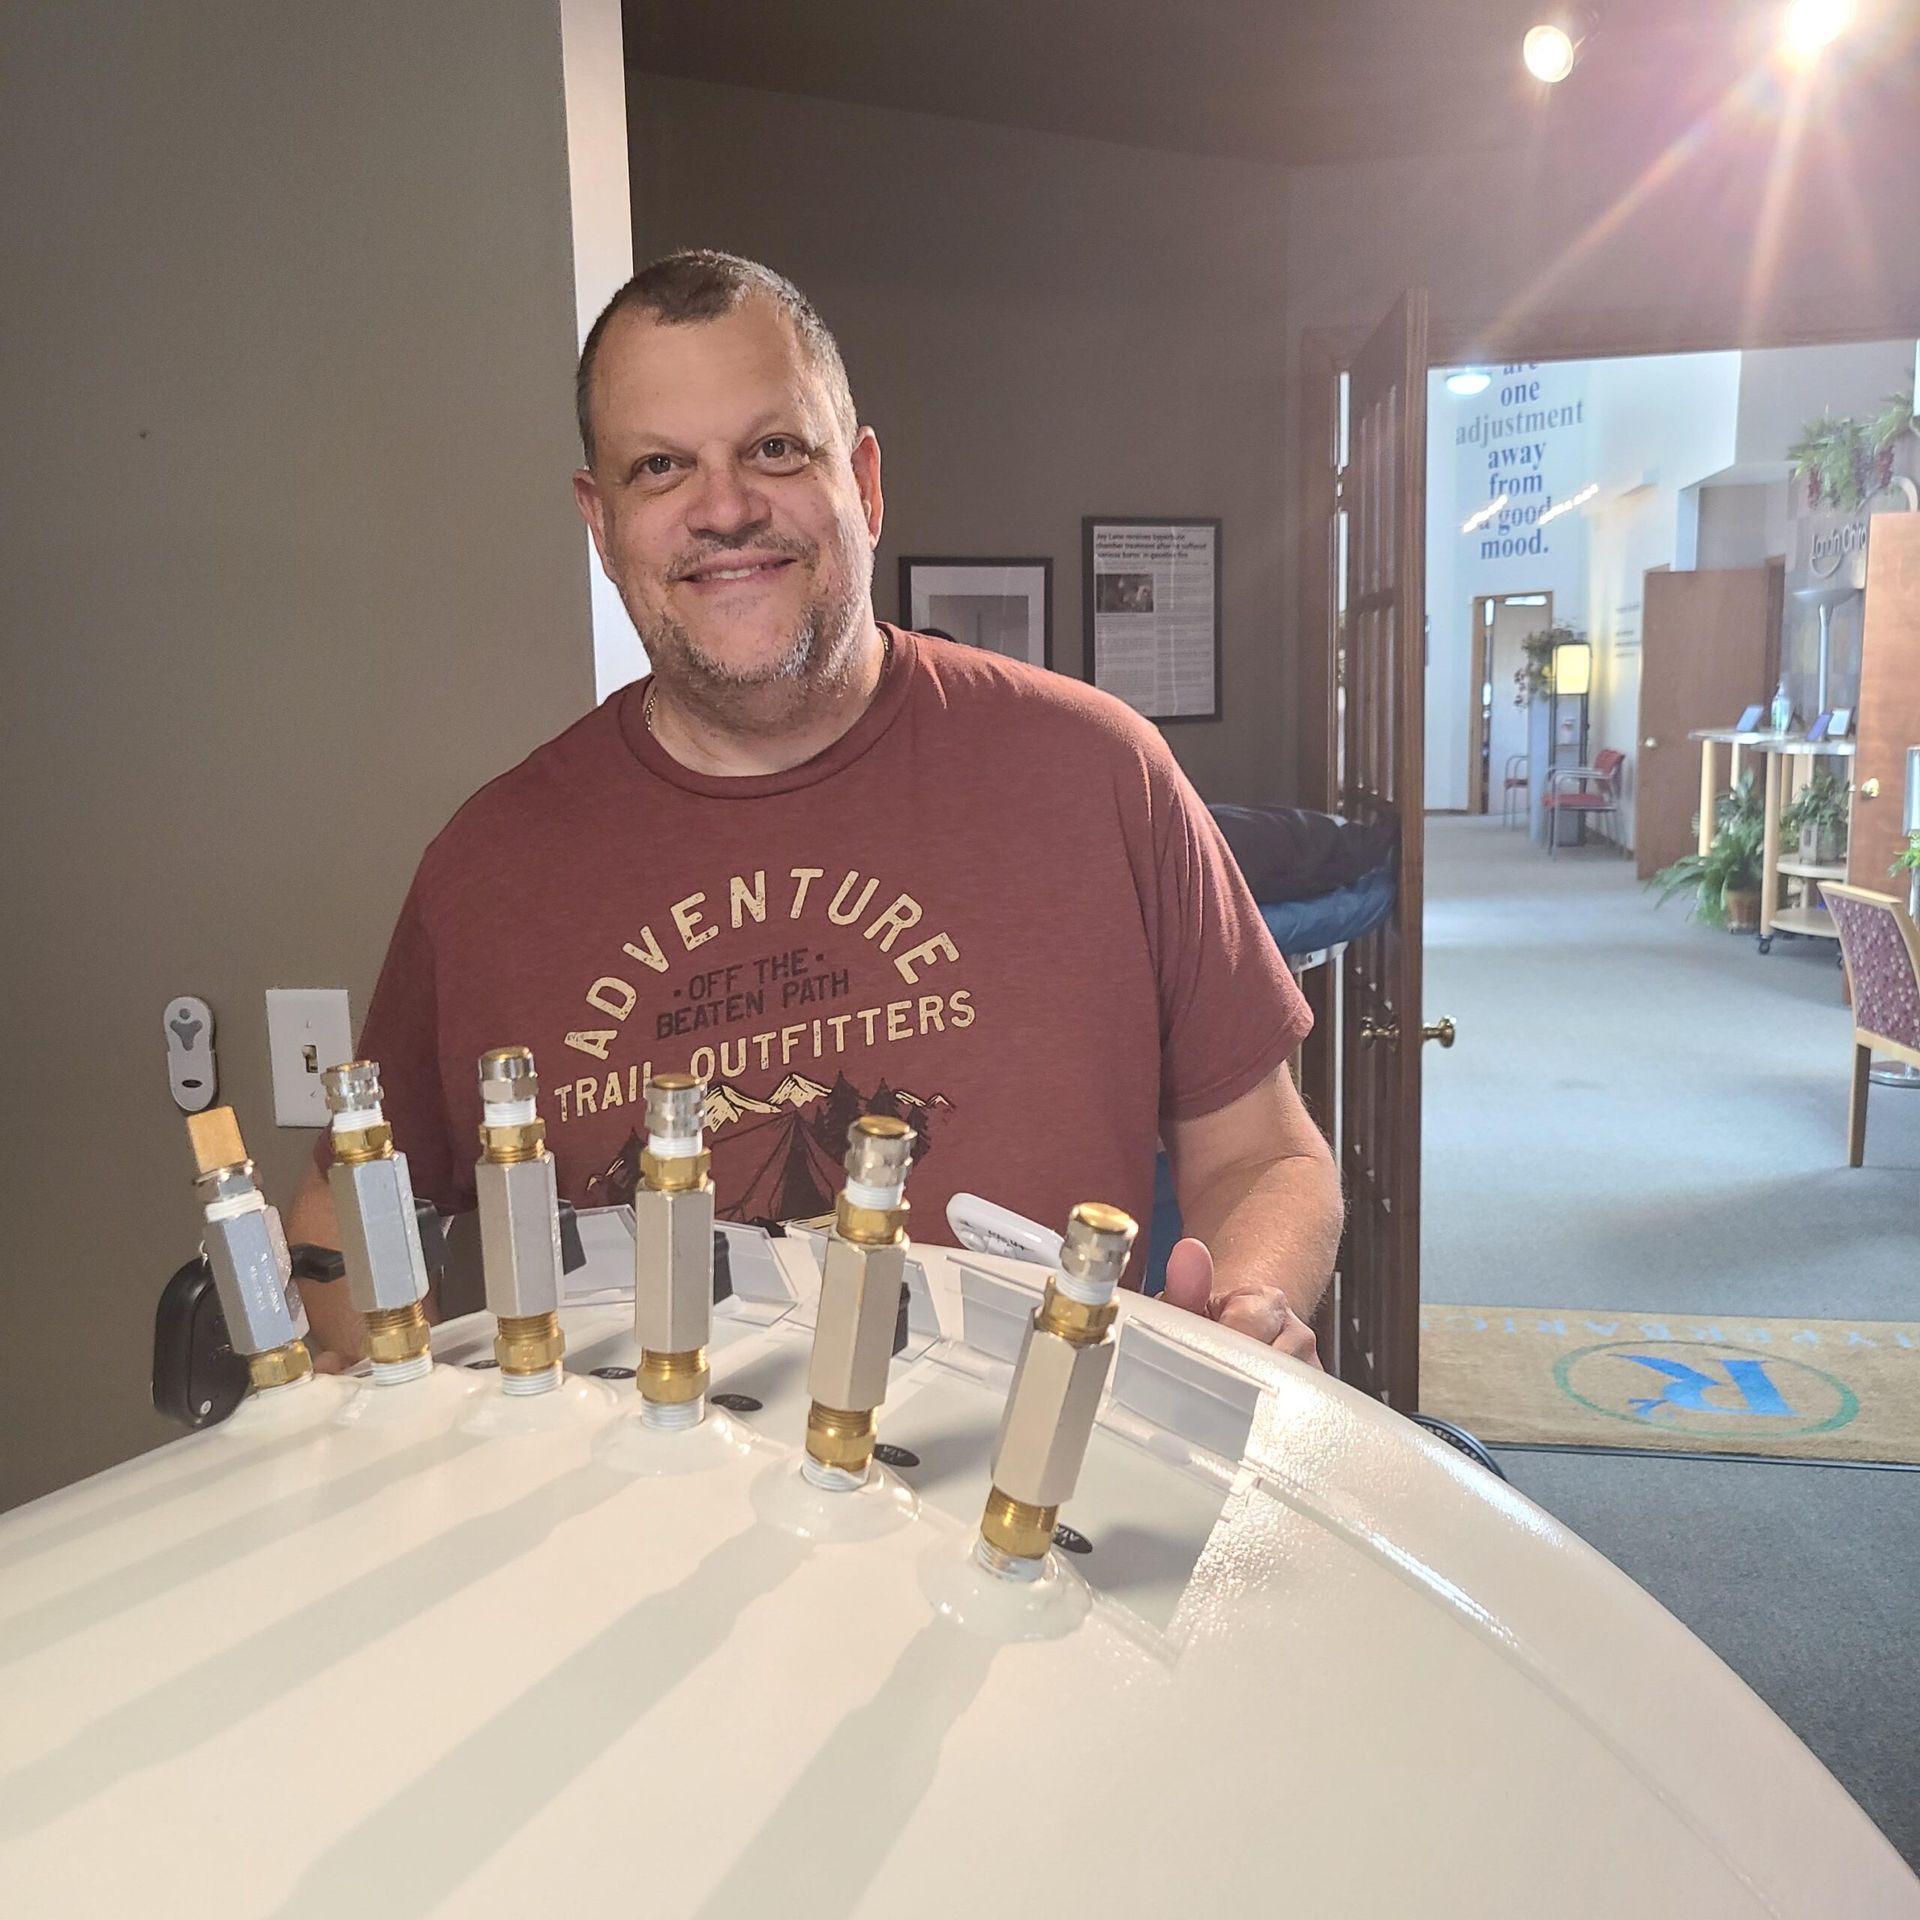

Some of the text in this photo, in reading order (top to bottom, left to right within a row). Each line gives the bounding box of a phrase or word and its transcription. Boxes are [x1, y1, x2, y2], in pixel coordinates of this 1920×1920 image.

[1500, 381, 1540, 407] one
[1455, 399, 1584, 449] adjustment
[1488, 442, 1547, 470] away
[1489, 473, 1543, 499] from
[1480, 528, 1549, 560] mood.
[563, 867, 961, 1061] ADVENTURE
[689, 947, 809, 1001] OFF THE
[656, 968, 850, 1040] BEATEN PATH
[690, 990, 977, 1084] OUTFITTERS
